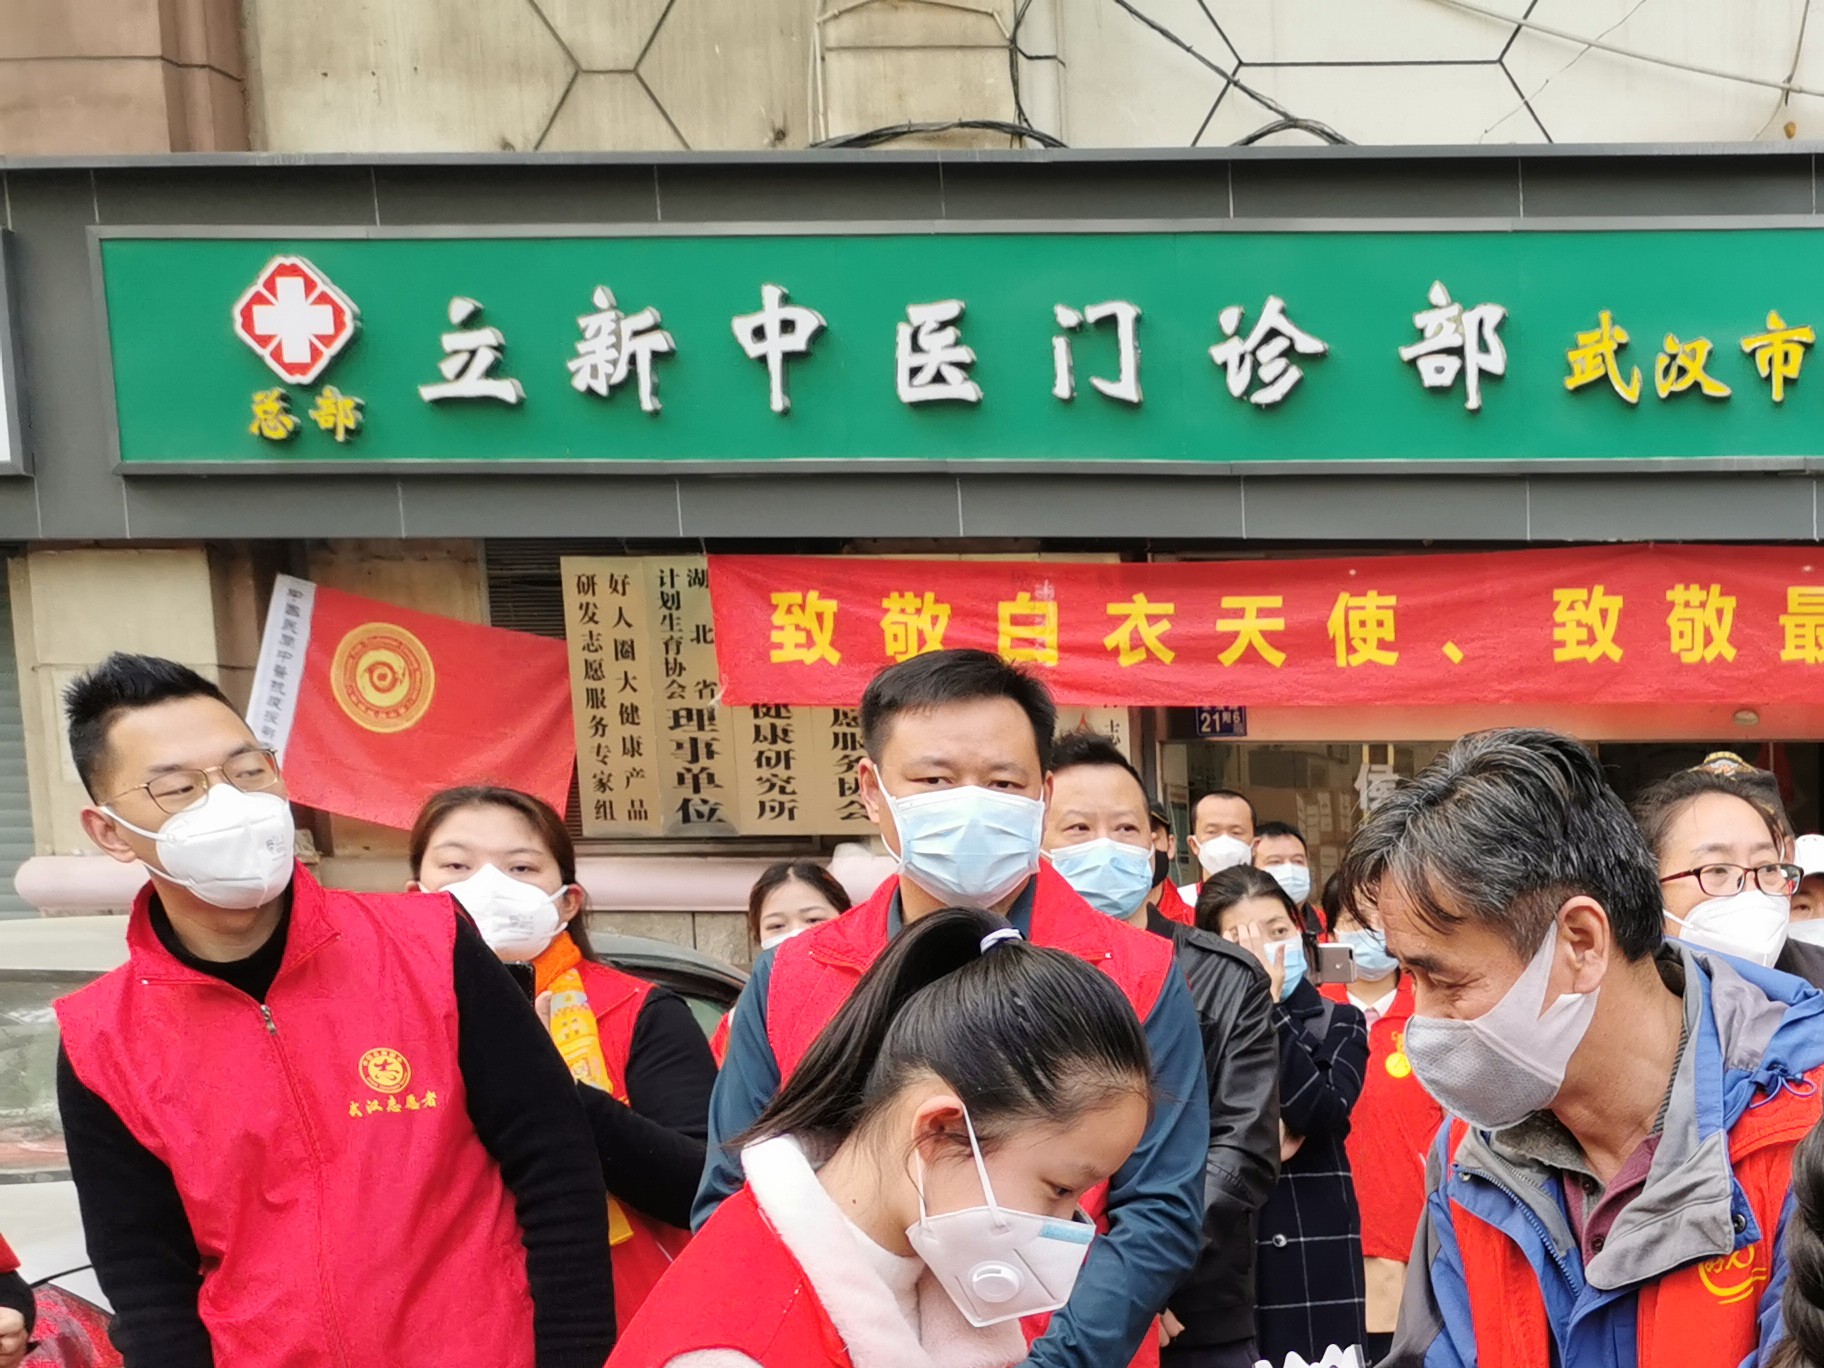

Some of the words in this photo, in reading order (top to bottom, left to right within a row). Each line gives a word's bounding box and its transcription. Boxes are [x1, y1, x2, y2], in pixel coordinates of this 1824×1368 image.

[250, 387, 364, 442] 总部
[418, 280, 1509, 415] 立新中医门诊部
[575, 573, 617, 823] 研发志愿服务专家组
[608, 572, 649, 822] 好人圈大健康产品
[658, 567, 688, 700] 计划生育协会
[667, 705, 727, 825] 理事单位
